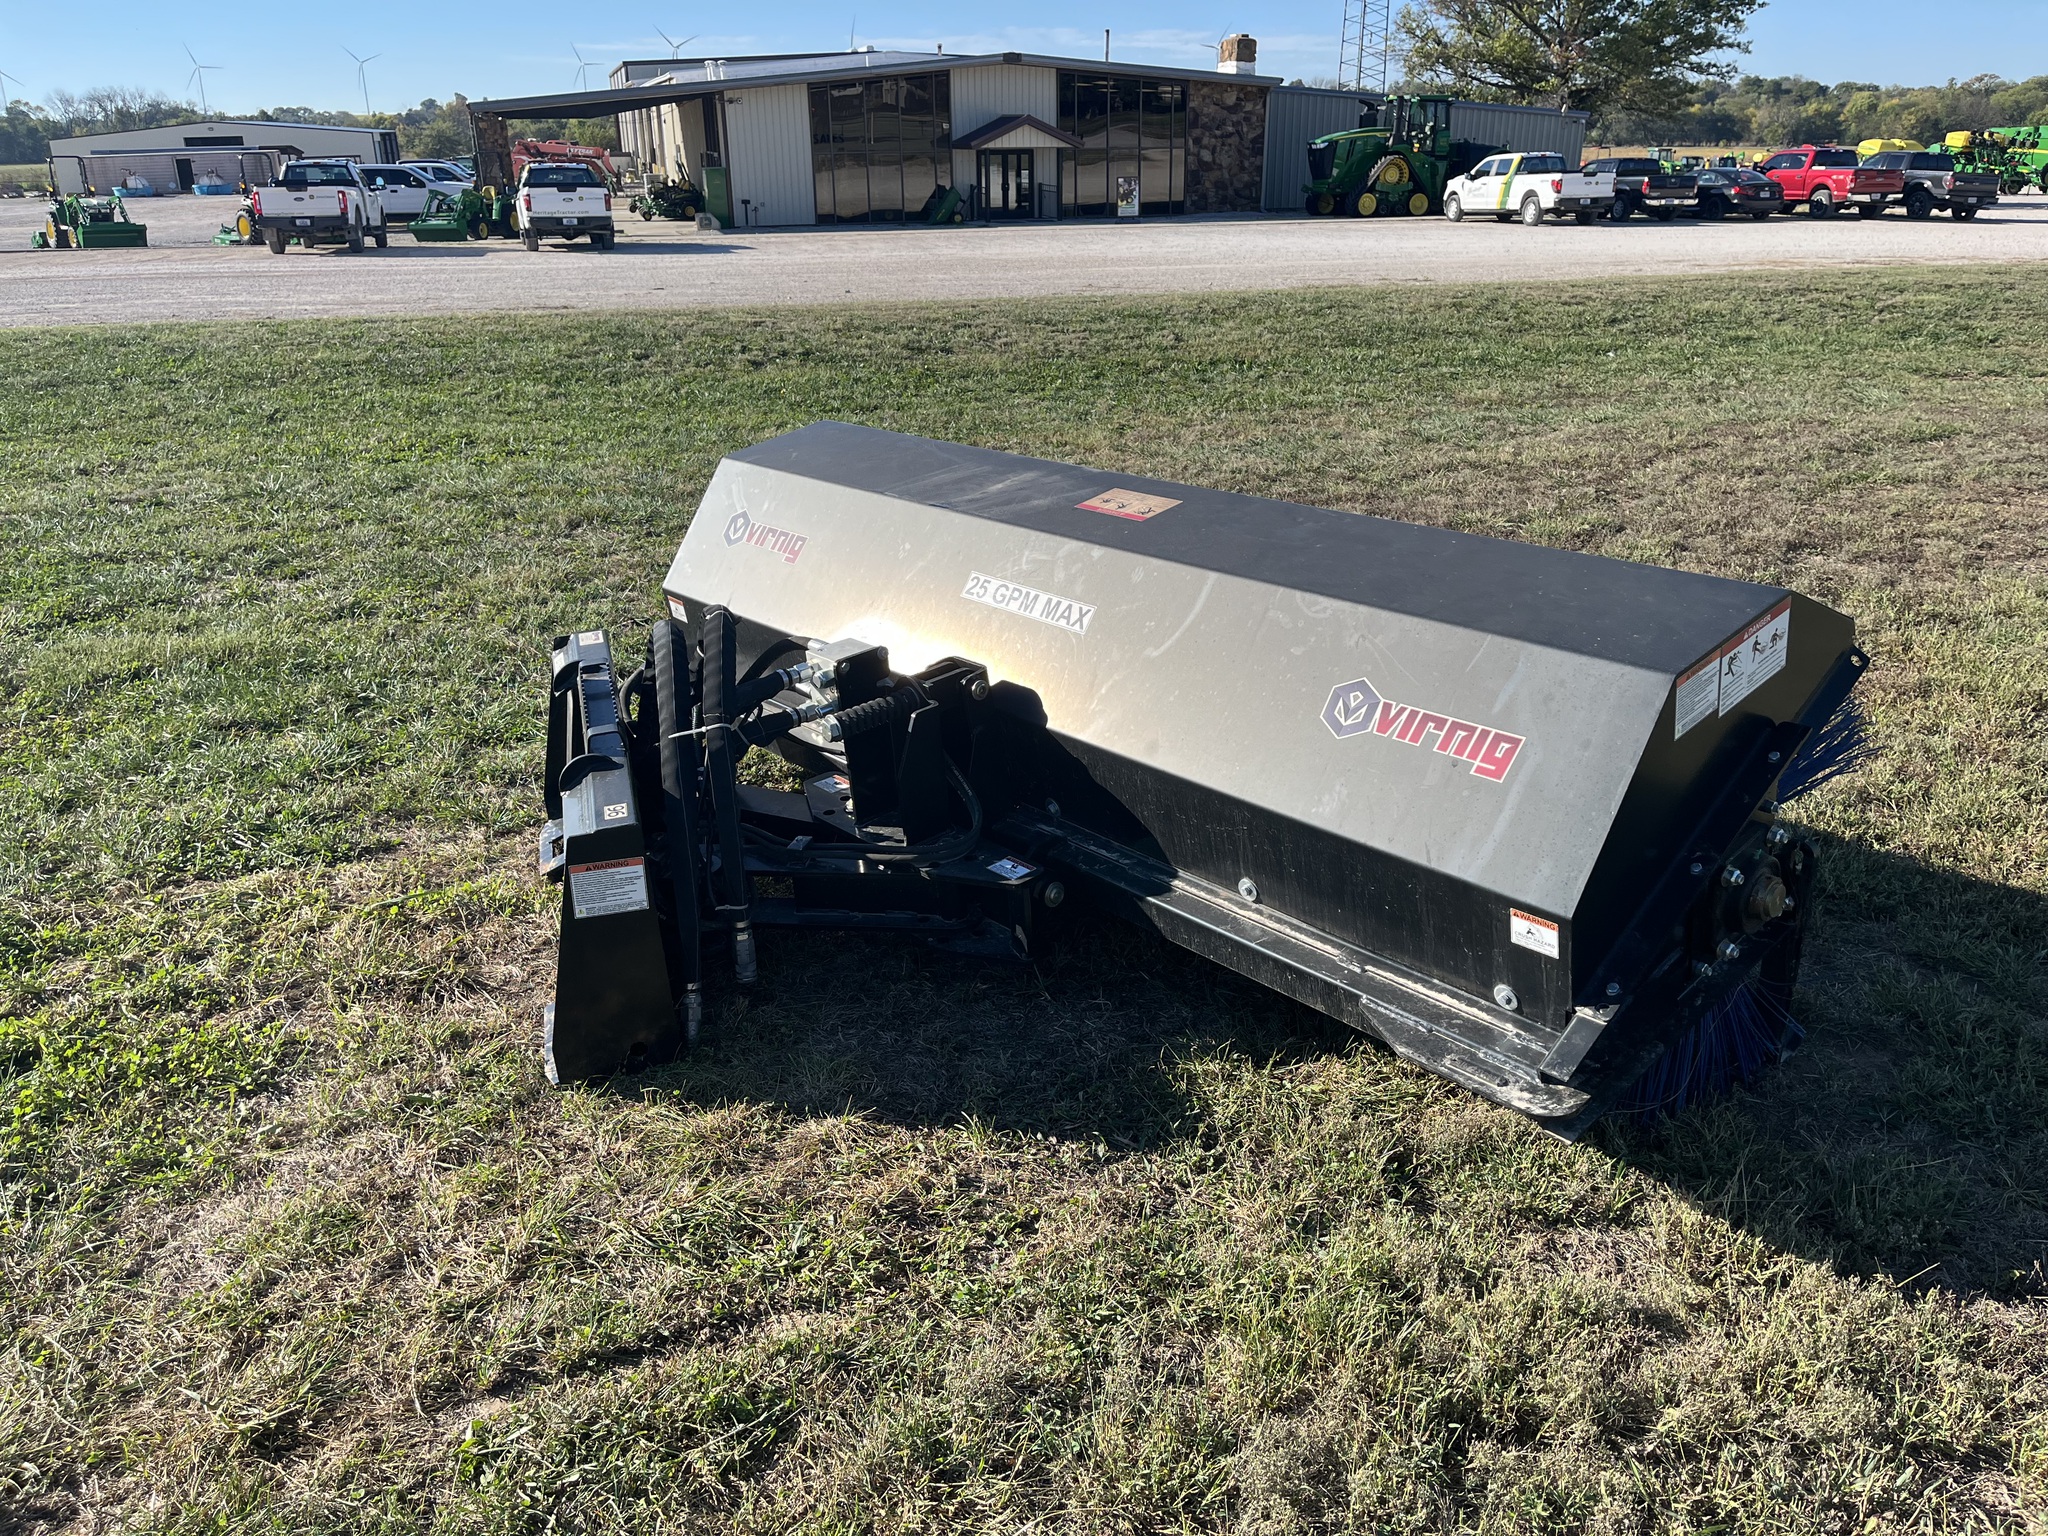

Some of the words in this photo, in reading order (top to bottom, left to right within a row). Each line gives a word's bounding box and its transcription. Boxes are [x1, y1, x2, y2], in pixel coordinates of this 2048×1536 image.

[965, 576, 991, 598] 25
[992, 583, 1040, 614] GPM
[1040, 597, 1092, 630] MAX
[1748, 614, 1771, 637] DANGER
[592, 860, 629, 870] WARNING
[1520, 913, 1556, 931] WARNING
